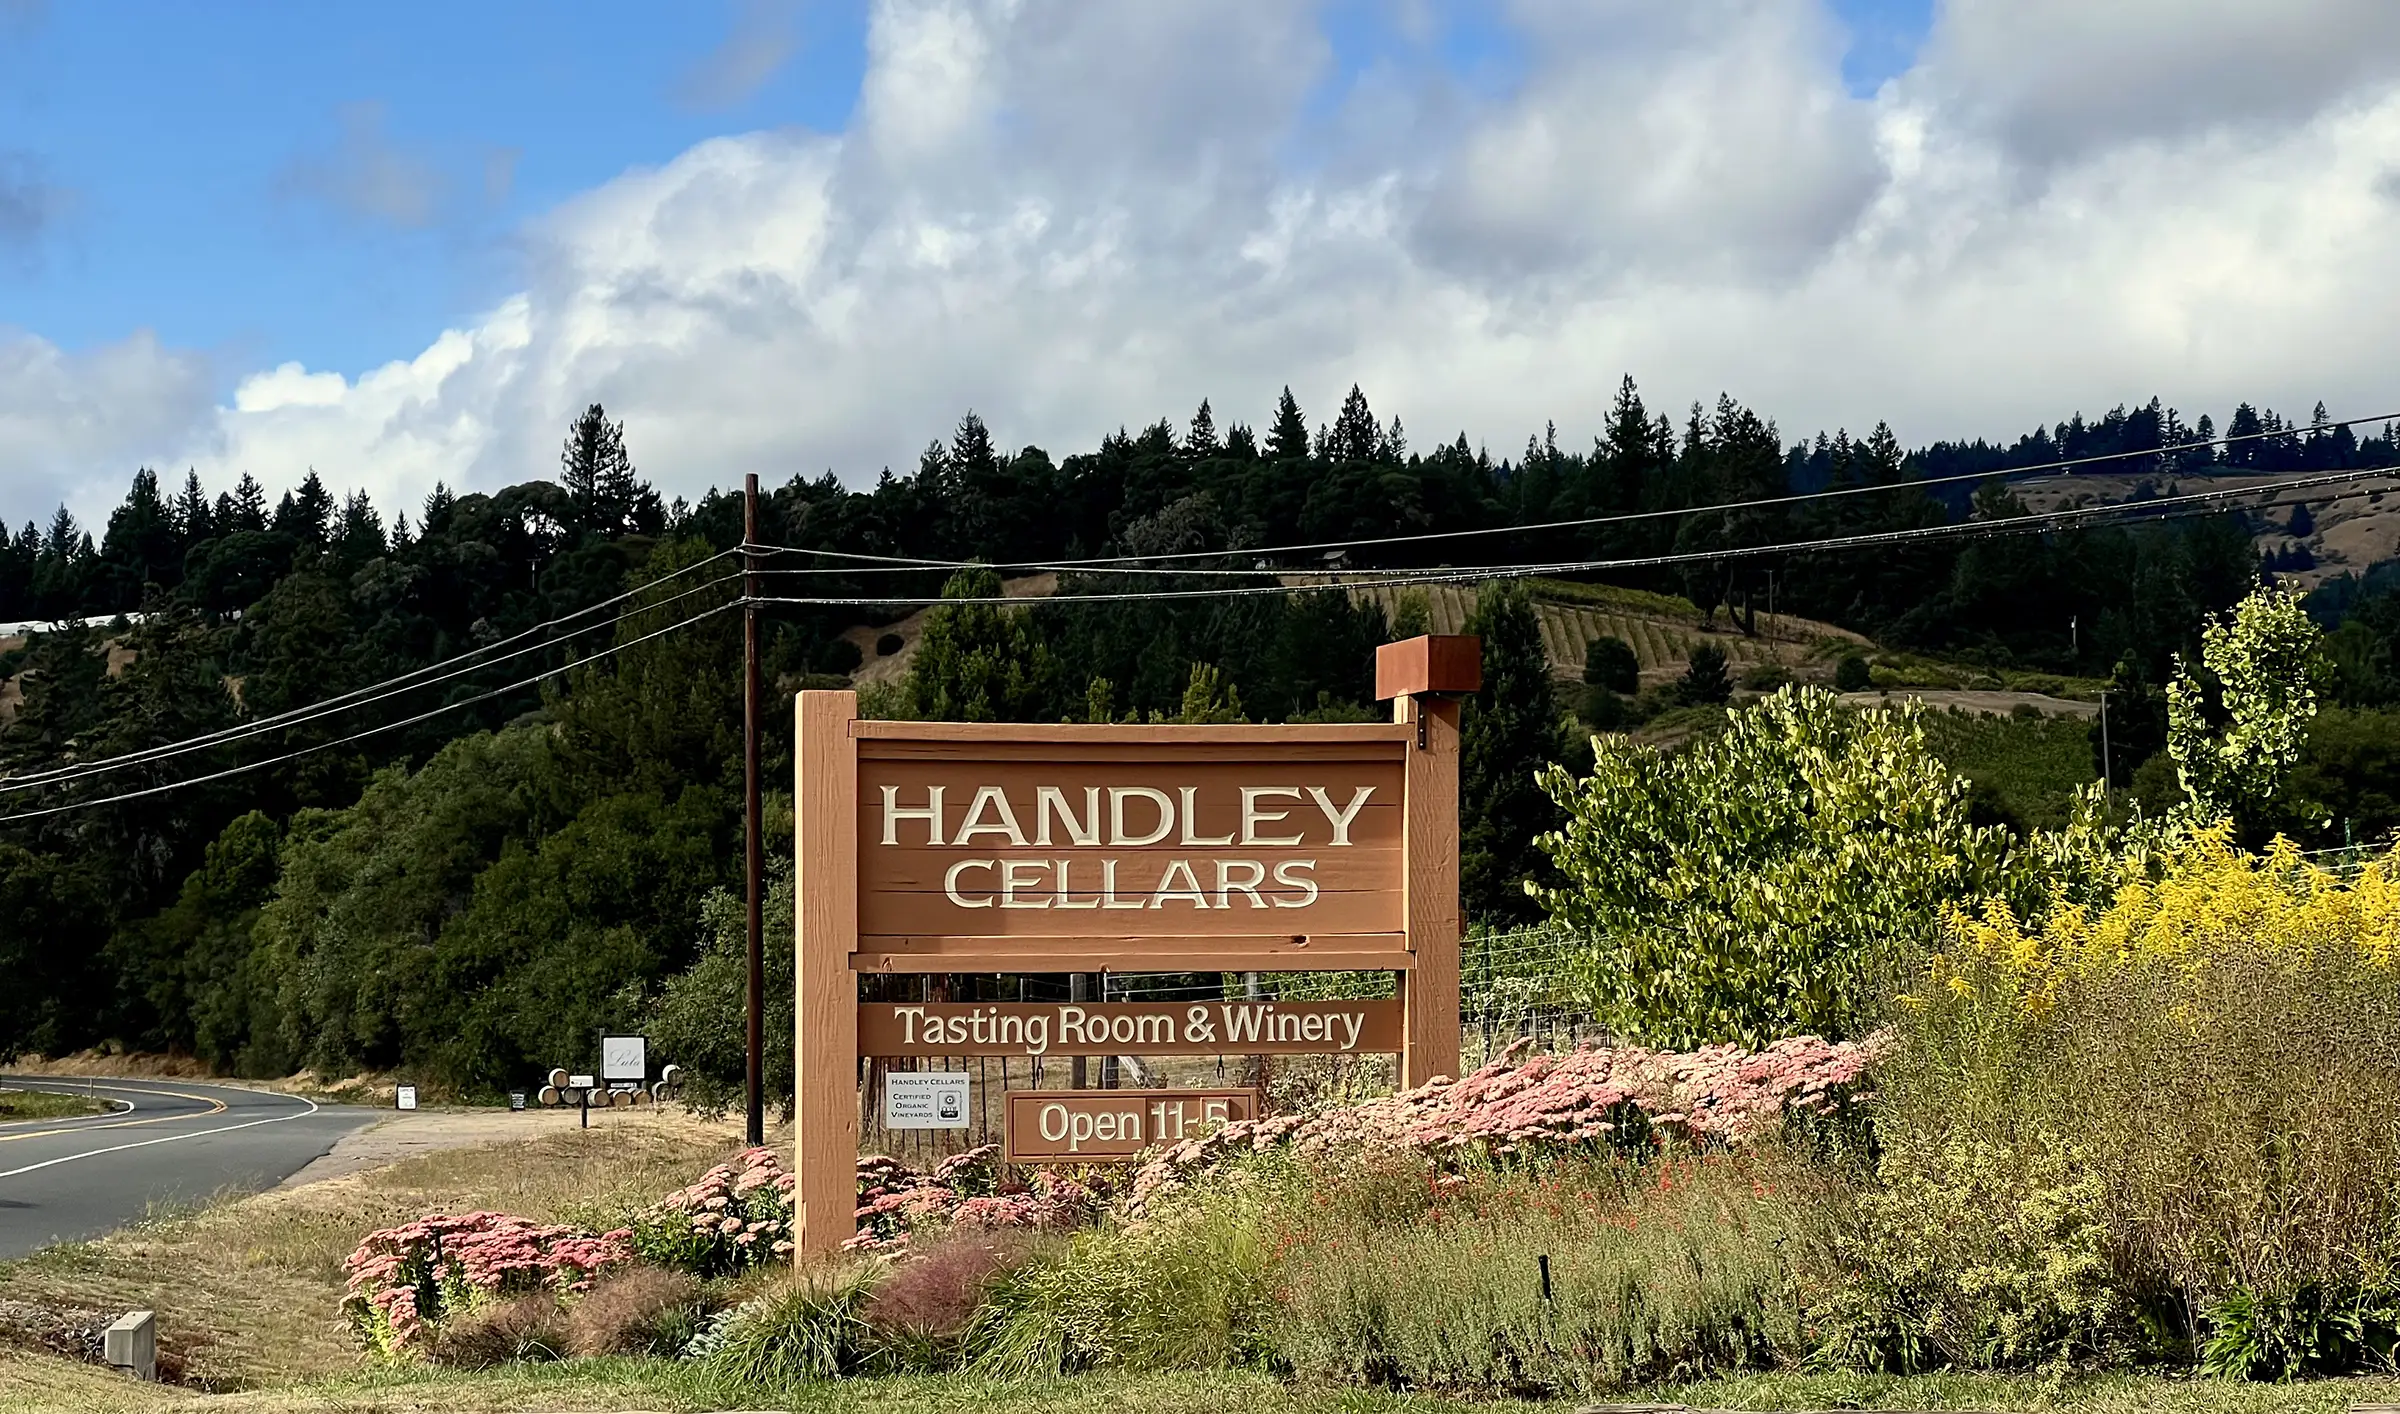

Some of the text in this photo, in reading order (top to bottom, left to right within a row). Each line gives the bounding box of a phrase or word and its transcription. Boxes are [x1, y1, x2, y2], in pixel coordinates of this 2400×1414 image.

[879, 784, 1377, 846] HANDLEY
[944, 859, 1319, 909] CELLARS
[894, 1003, 1365, 1054] Tasting Room & Winery
[1039, 1102, 1141, 1152] Open
